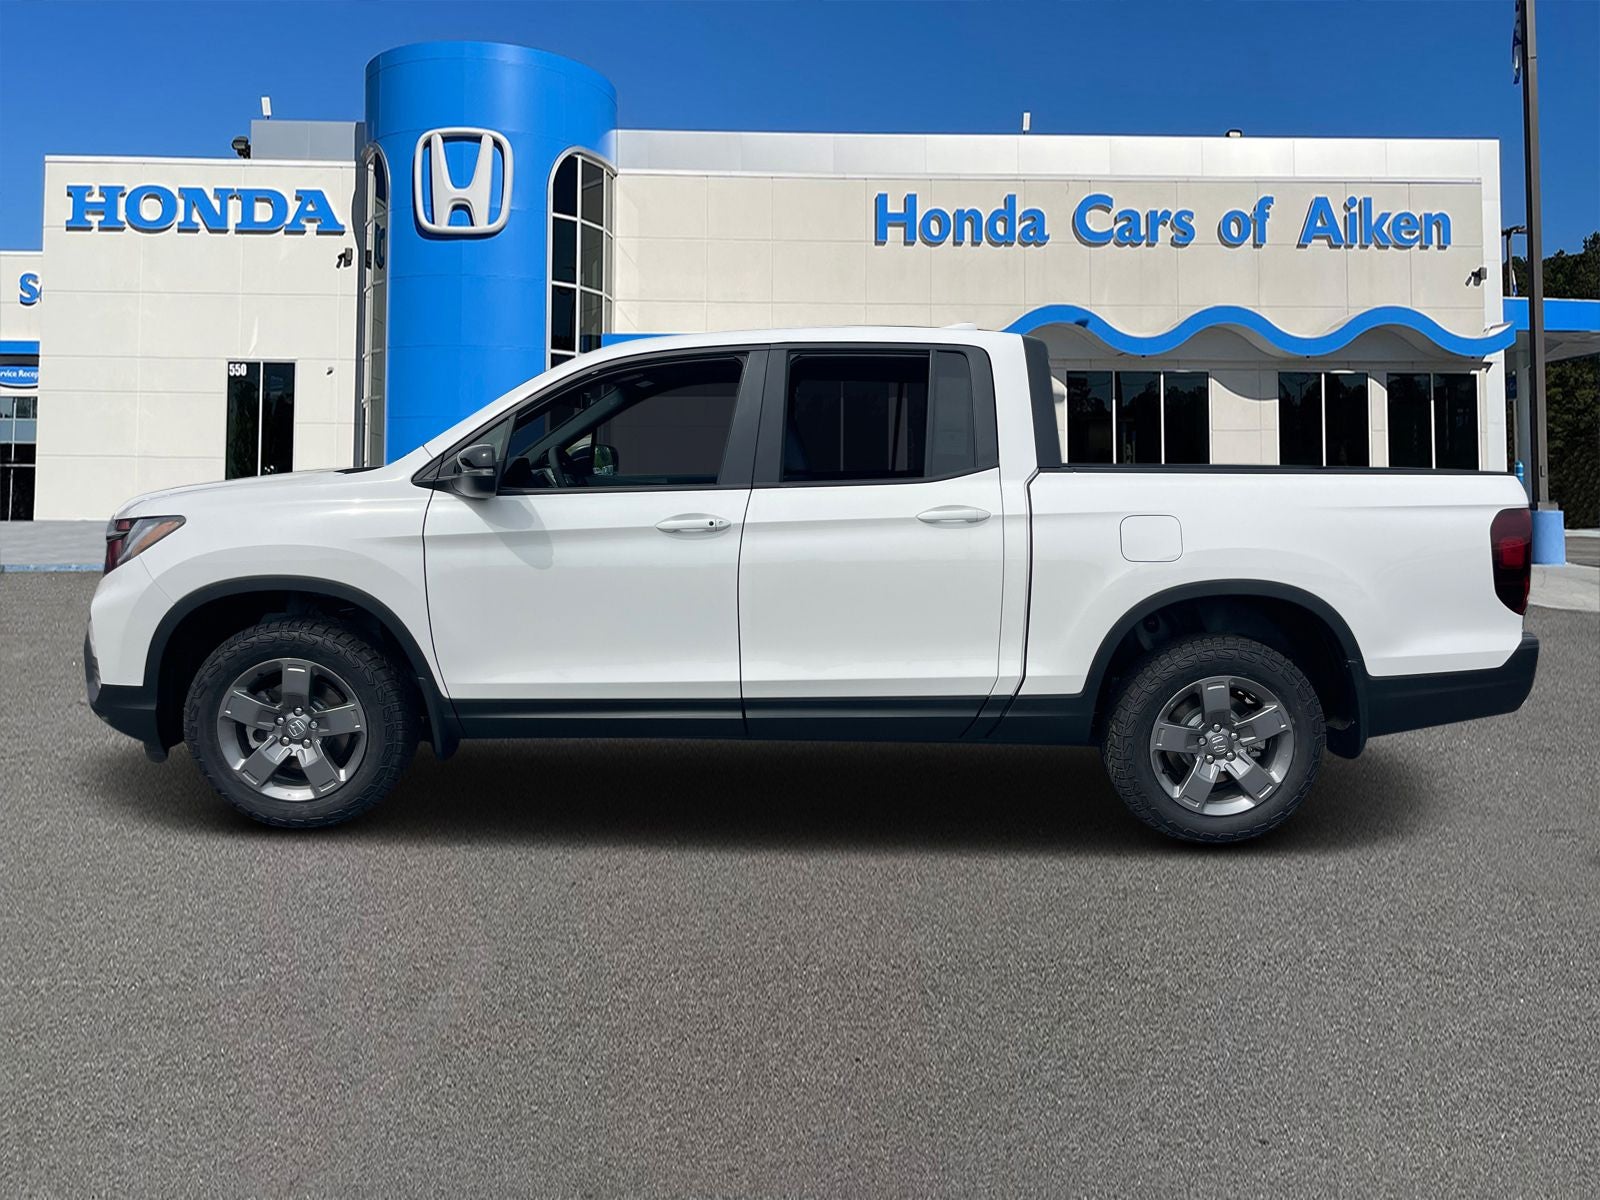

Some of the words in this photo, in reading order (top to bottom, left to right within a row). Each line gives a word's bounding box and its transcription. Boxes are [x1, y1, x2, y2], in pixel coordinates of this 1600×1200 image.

[66, 184, 346, 236] HONDA
[874, 192, 1050, 248] Honda
[1072, 193, 1196, 248] Cars
[1217, 196, 1275, 248] of
[1296, 196, 1452, 250] Aiken
[19, 272, 42, 306] S
[228, 363, 247, 377] 550
